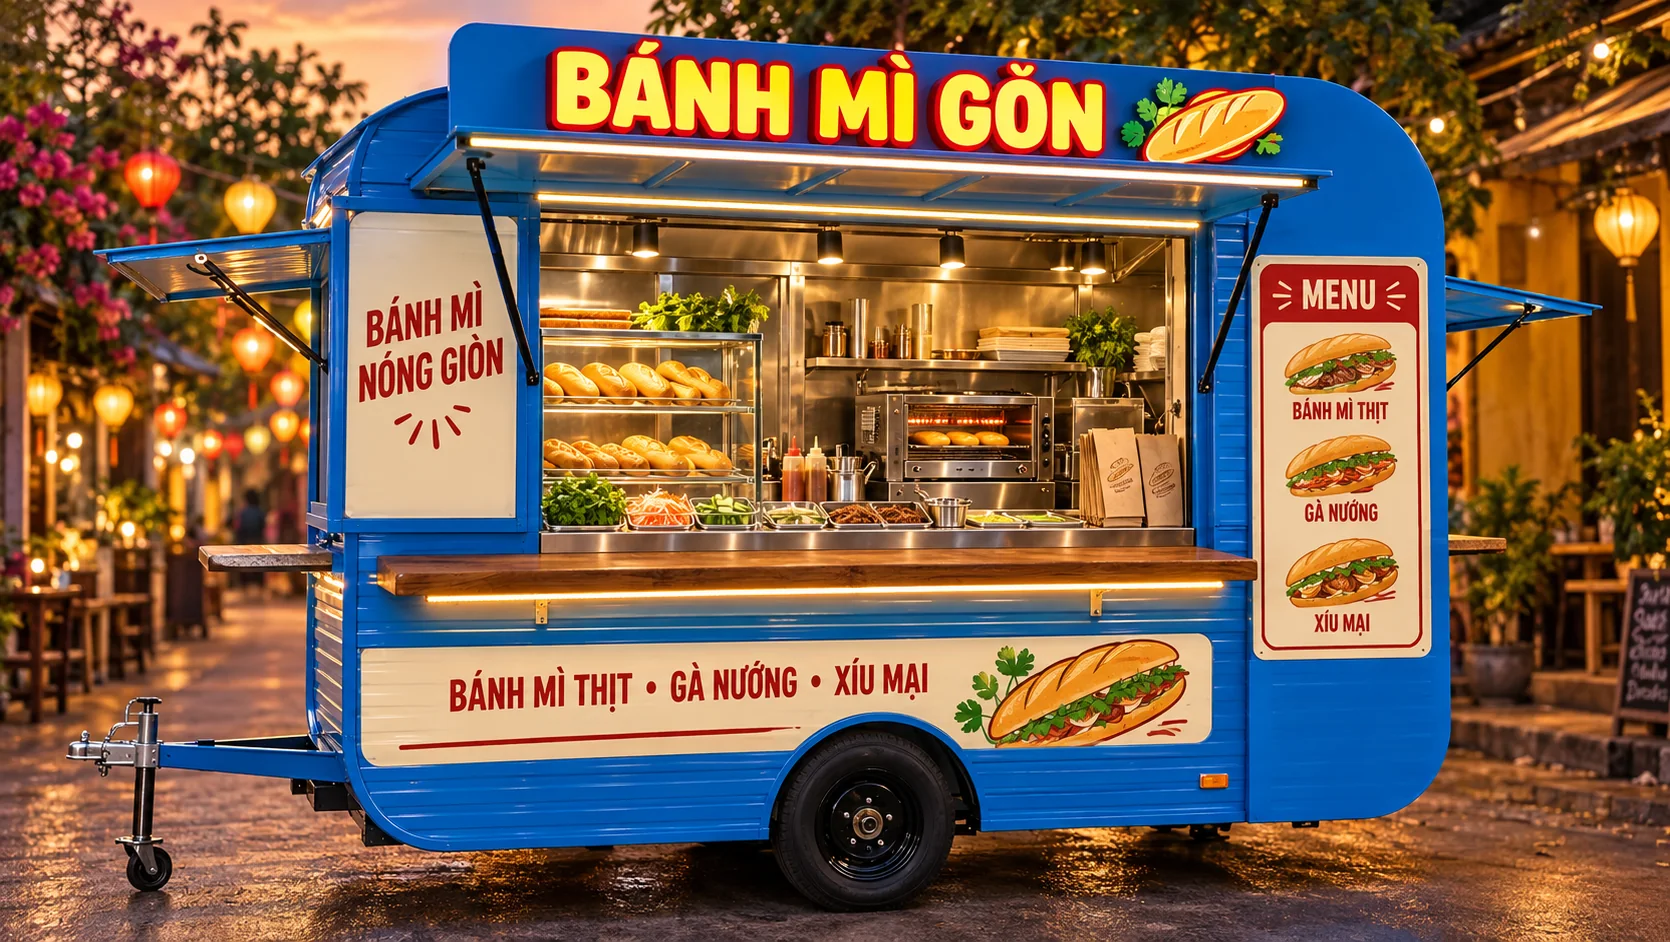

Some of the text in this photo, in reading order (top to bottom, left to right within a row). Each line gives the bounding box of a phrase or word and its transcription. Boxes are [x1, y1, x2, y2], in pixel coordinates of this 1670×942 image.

[547, 37, 795, 138] BÁNH
[810, 50, 917, 147] MÌ
[366, 280, 483, 348] BÁNH MÌ
[1302, 279, 1376, 310] MENU
[358, 333, 504, 403] NÓNG GIÒN
[1292, 397, 1389, 424] BÁNH MÌ THỊT
[1305, 499, 1378, 522] GÀ NƯỚNG
[1314, 609, 1370, 636] XÍU MẠI
[449, 657, 928, 713] BÁNH MÌ THỊT GÀ NƯỚNG XÍU MẠI
